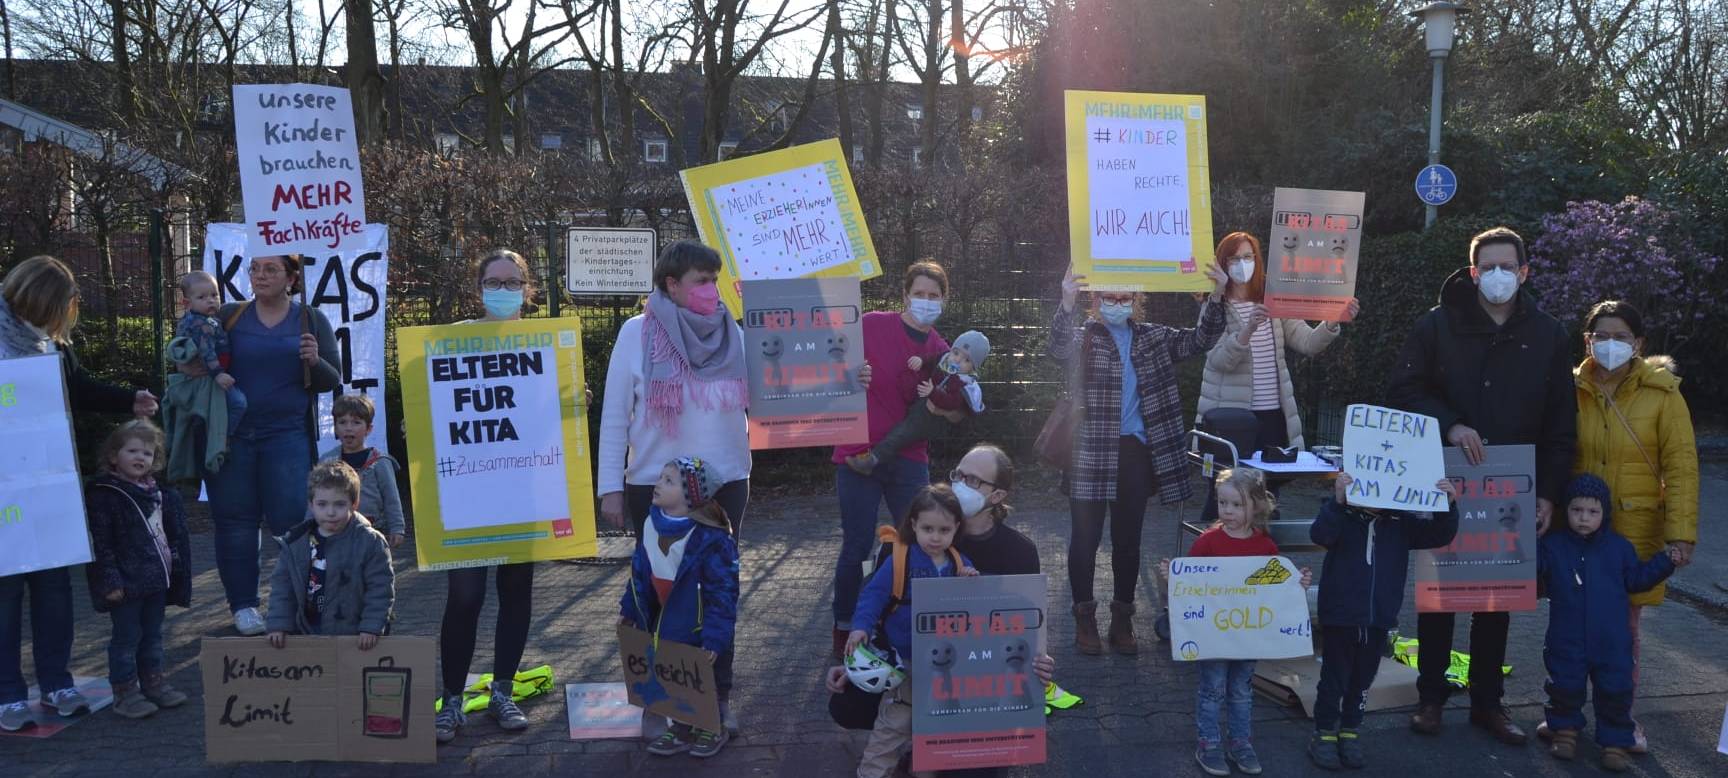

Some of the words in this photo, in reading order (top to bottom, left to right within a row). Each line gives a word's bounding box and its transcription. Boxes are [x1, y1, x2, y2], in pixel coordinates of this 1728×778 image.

[264, 118, 346, 145] Kinder
[1119, 128, 1177, 146] KINDER
[260, 150, 354, 175] brauchen
[1097, 159, 1136, 170] HABEN
[271, 181, 352, 211] MEHR
[727, 190, 768, 216] MEINE
[1095, 208, 1128, 236] WIR
[1136, 208, 1190, 236] AUCH!
[582, 235, 648, 244] Privatparkplätze
[752, 229, 781, 246] SIND
[782, 218, 830, 255] MEHR
[588, 268, 633, 276] einrichtung
[597, 279, 647, 287] Winterdienst
[794, 342, 815, 351] AM
[432, 351, 544, 382] ELTERN
[763, 363, 848, 387] LIMIT
[453, 384, 517, 412] FÜR
[449, 417, 519, 445] KITA
[1350, 406, 1427, 438] ELTERN
[438, 446, 563, 477] #Zusammenhalt
[1355, 453, 1408, 476] KITAS
[1350, 478, 1381, 498] AM
[1393, 485, 1445, 508] LIMIT
[1464, 511, 1487, 520] AM
[1171, 560, 1220, 575] Unsere
[1183, 605, 1205, 620] sind
[1213, 606, 1275, 631] GOLD
[968, 650, 993, 660] AM
[627, 653, 648, 676] es
[655, 658, 705, 694] reicht
[932, 673, 1027, 700] LIMIT
[219, 695, 294, 727] Limit
